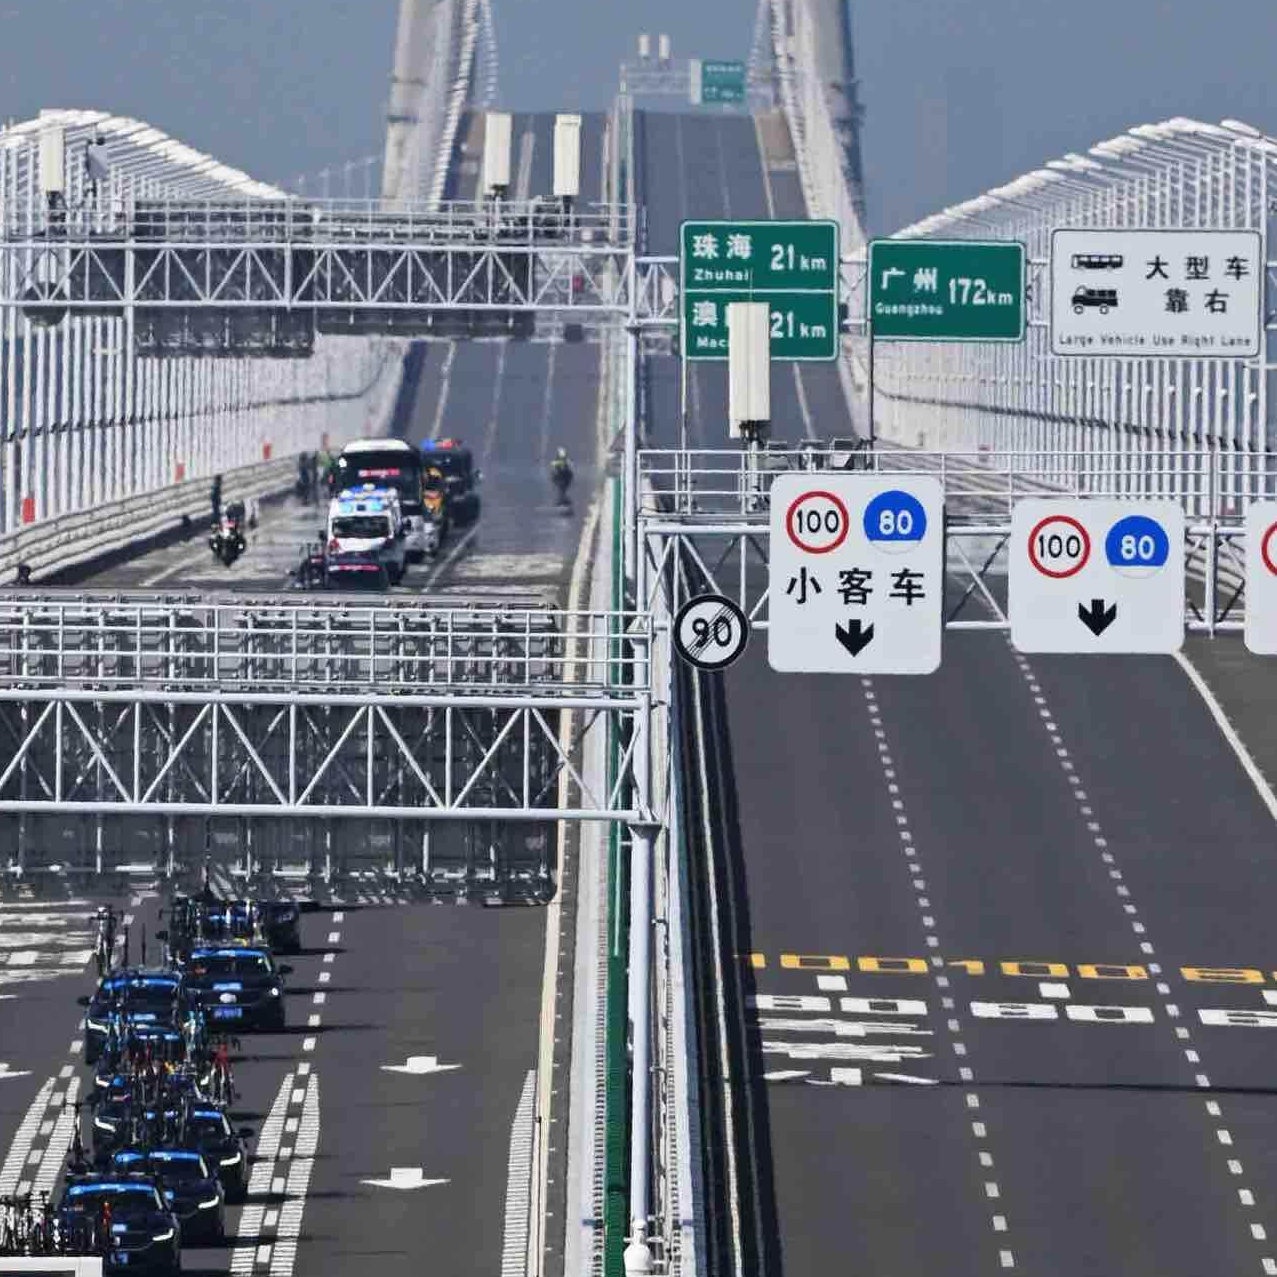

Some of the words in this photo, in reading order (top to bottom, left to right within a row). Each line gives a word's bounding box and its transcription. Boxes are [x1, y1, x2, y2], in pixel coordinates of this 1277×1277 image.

[692, 233, 752, 259] 珠海
[770, 244, 795, 270] 21
[800, 255, 827, 270] km
[693, 268, 749, 281] Zhuhai
[881, 267, 939, 293] 广州
[1145, 255, 1250, 281] 大型车
[692, 300, 730, 327] 澳
[875, 302, 944, 317] Guangzhou
[1165, 287, 1230, 314] 靠右
[770, 311, 795, 338] 21
[800, 323, 827, 338] km
[1059, 334, 1093, 348] Large
[1100, 333, 1145, 346] Vehicle
[1152, 334, 1175, 346] Use
[1181, 333, 1215, 348] Right
[1221, 334, 1251, 346] Lane
[796, 509, 840, 534] 100
[879, 509, 914, 535] 80
[1037, 534, 1081, 559] 100
[1120, 534, 1155, 560] 80
[786, 566, 926, 606] 小客车
[691, 615, 733, 648] 90
[969, 1001, 1155, 1024] 80
